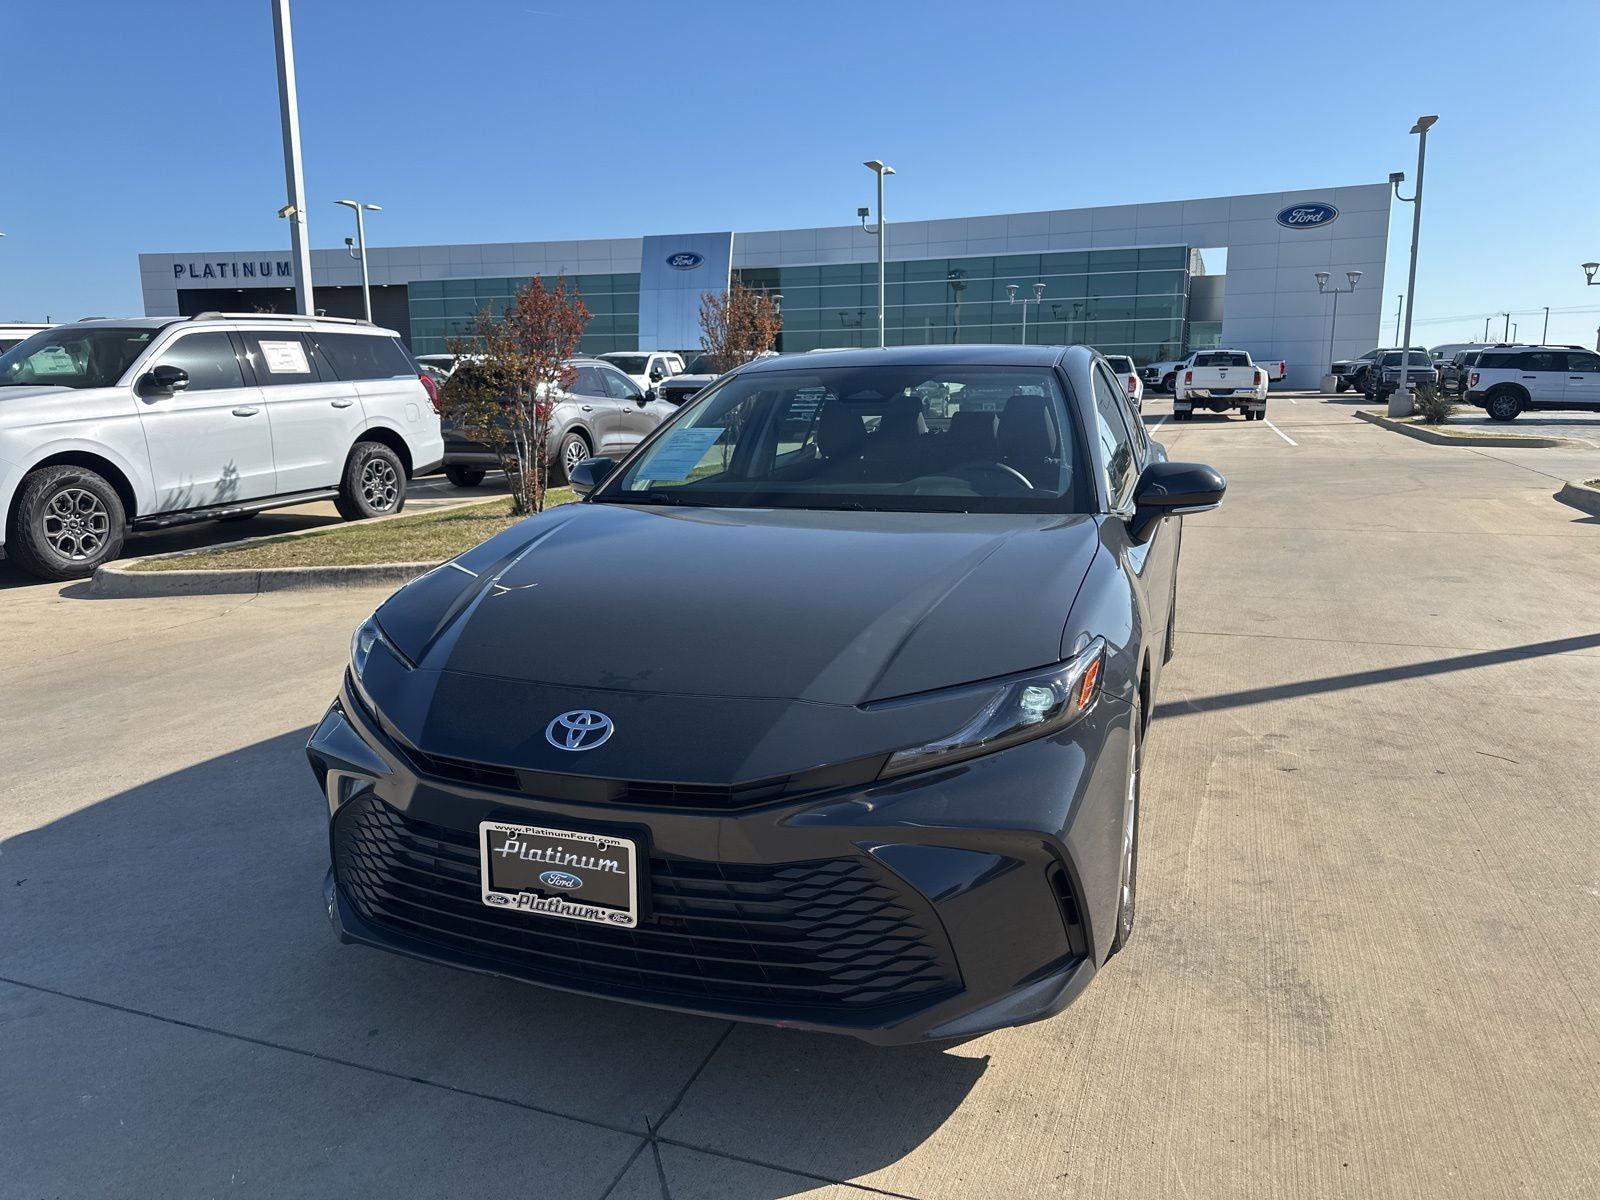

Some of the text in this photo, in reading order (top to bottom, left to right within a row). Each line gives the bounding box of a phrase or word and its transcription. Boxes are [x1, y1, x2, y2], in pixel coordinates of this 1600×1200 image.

[1288, 208, 1324, 223] Ford
[672, 255, 695, 266] Ford
[173, 261, 291, 279] PLATINUM
[495, 824, 621, 846] www.PlatinumFord.com
[493, 840, 626, 875] Platinum
[547, 873, 575, 888] Ford
[516, 893, 606, 921] Platinum
